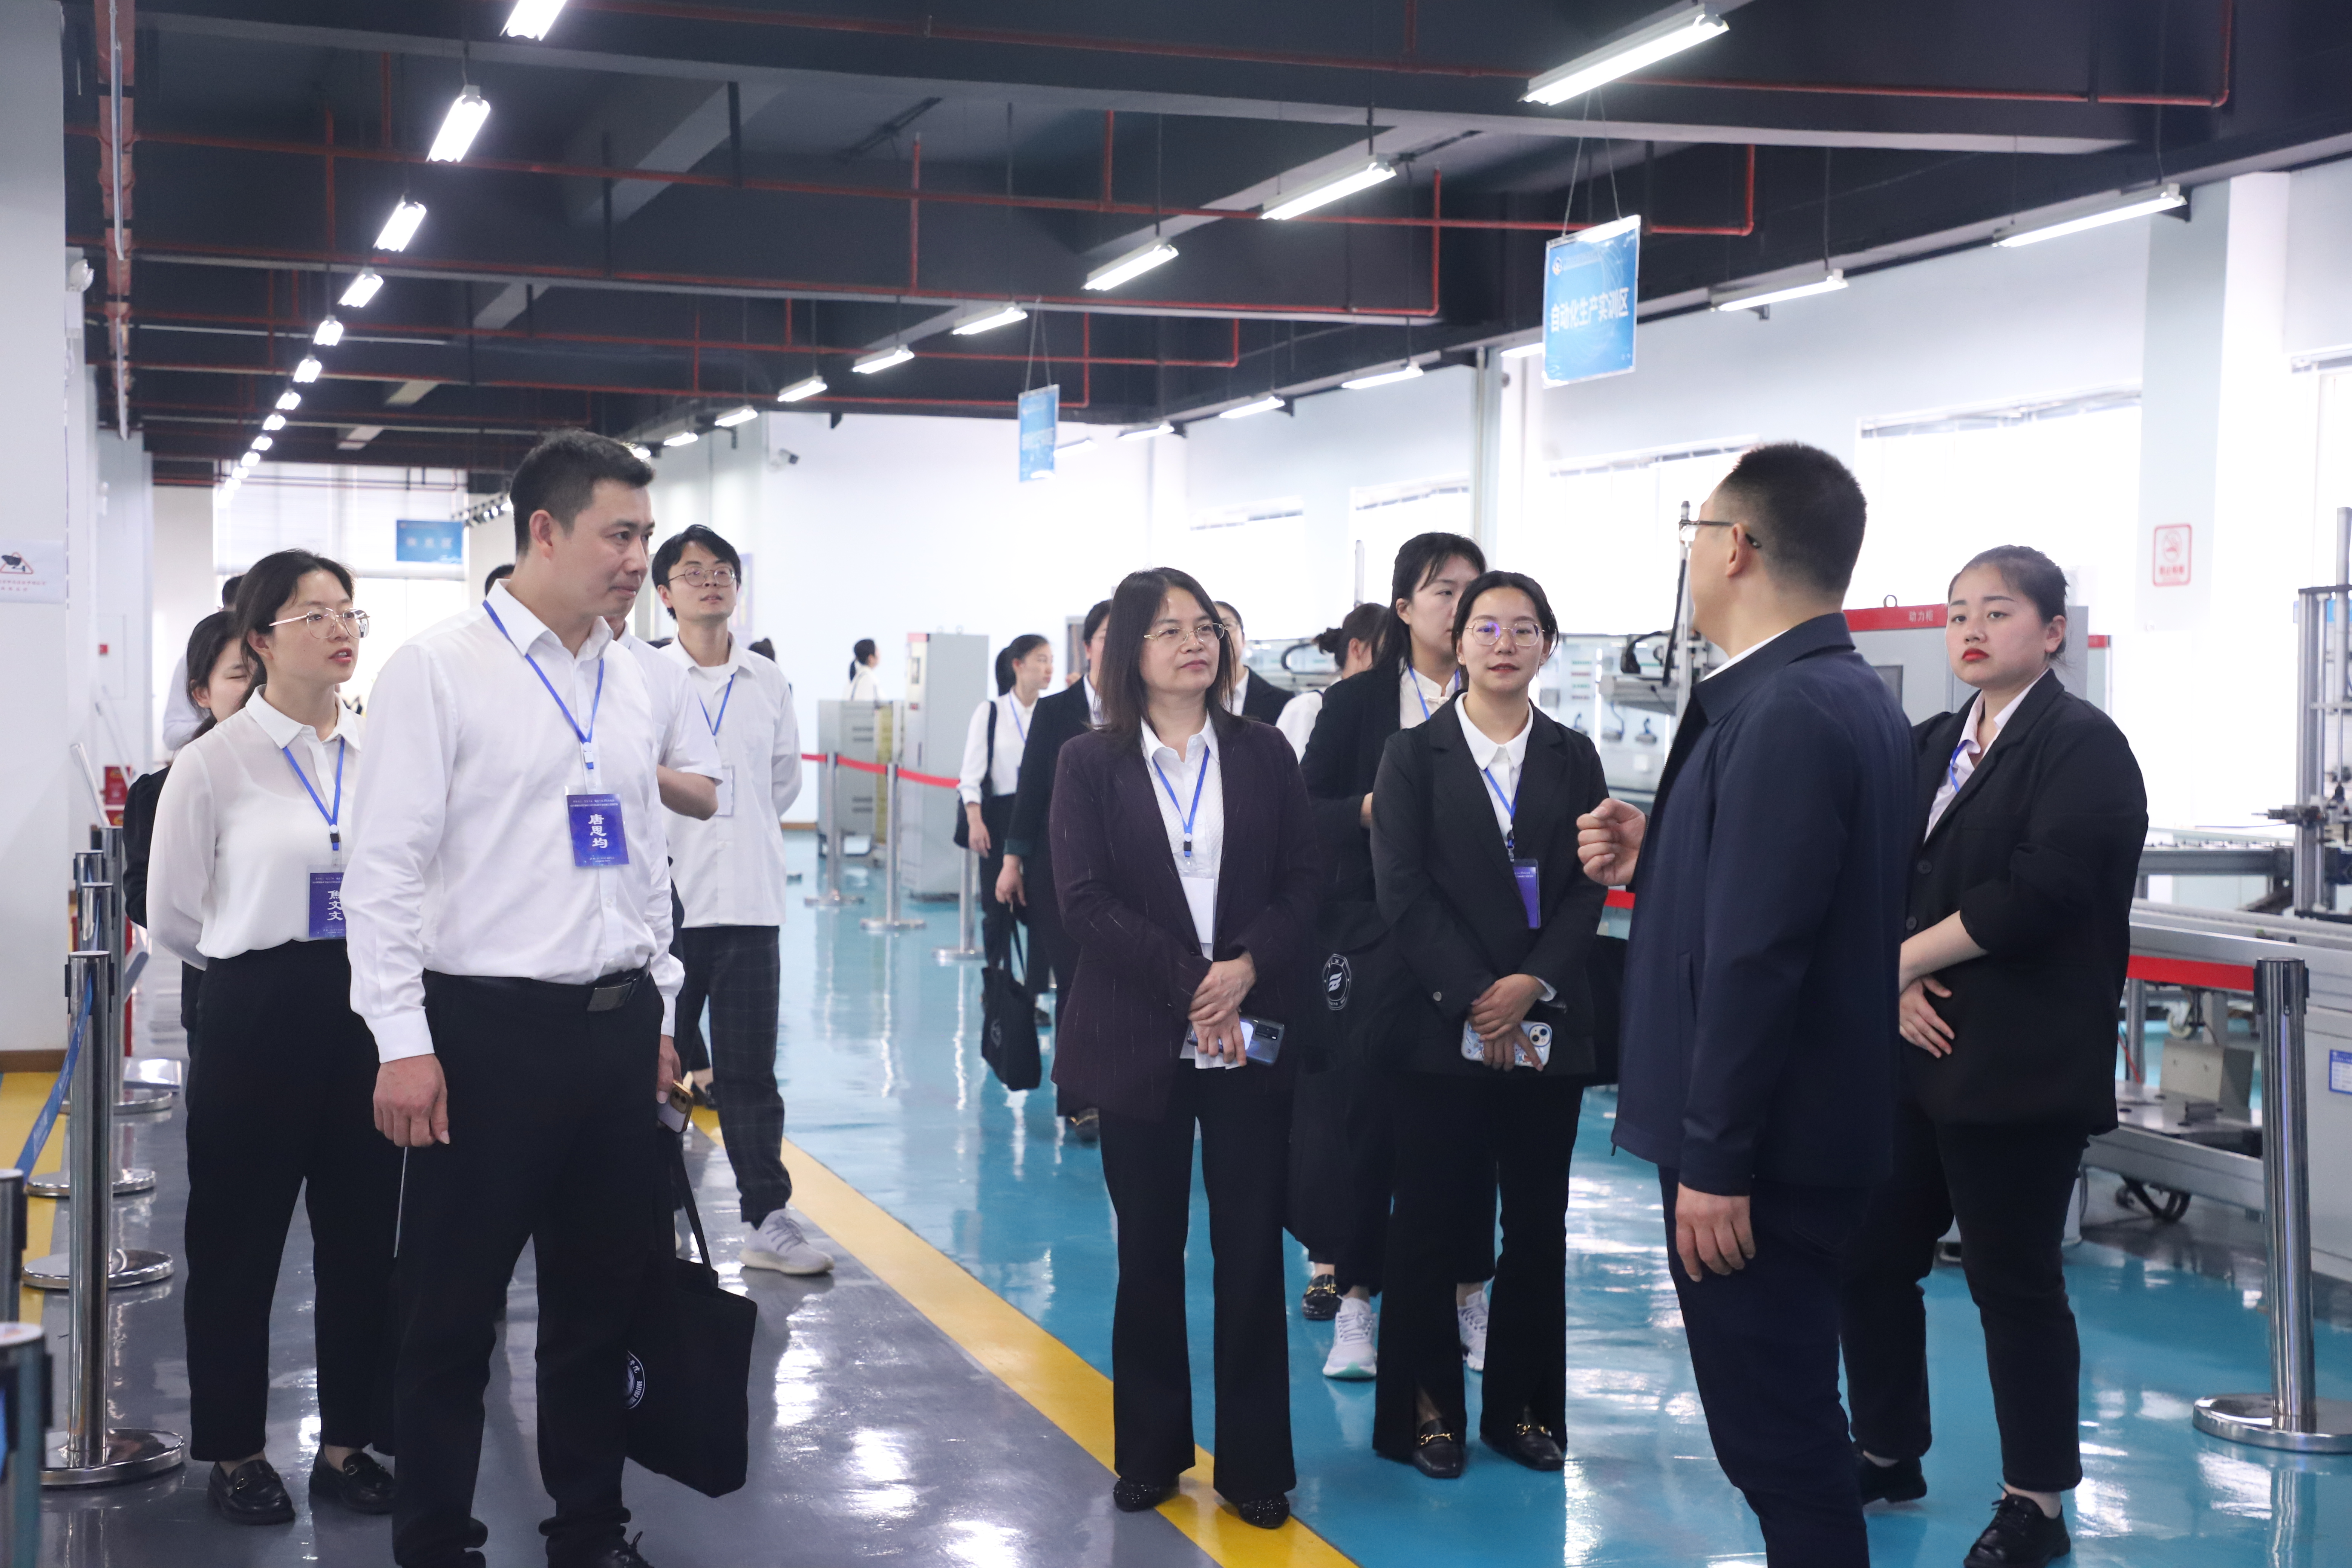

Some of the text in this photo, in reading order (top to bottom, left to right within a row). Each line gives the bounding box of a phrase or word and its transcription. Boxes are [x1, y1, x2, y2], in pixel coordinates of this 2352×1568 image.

[1551, 287, 1629, 333] 自动化生产实训区
[588, 813, 608, 848] 唐思均
